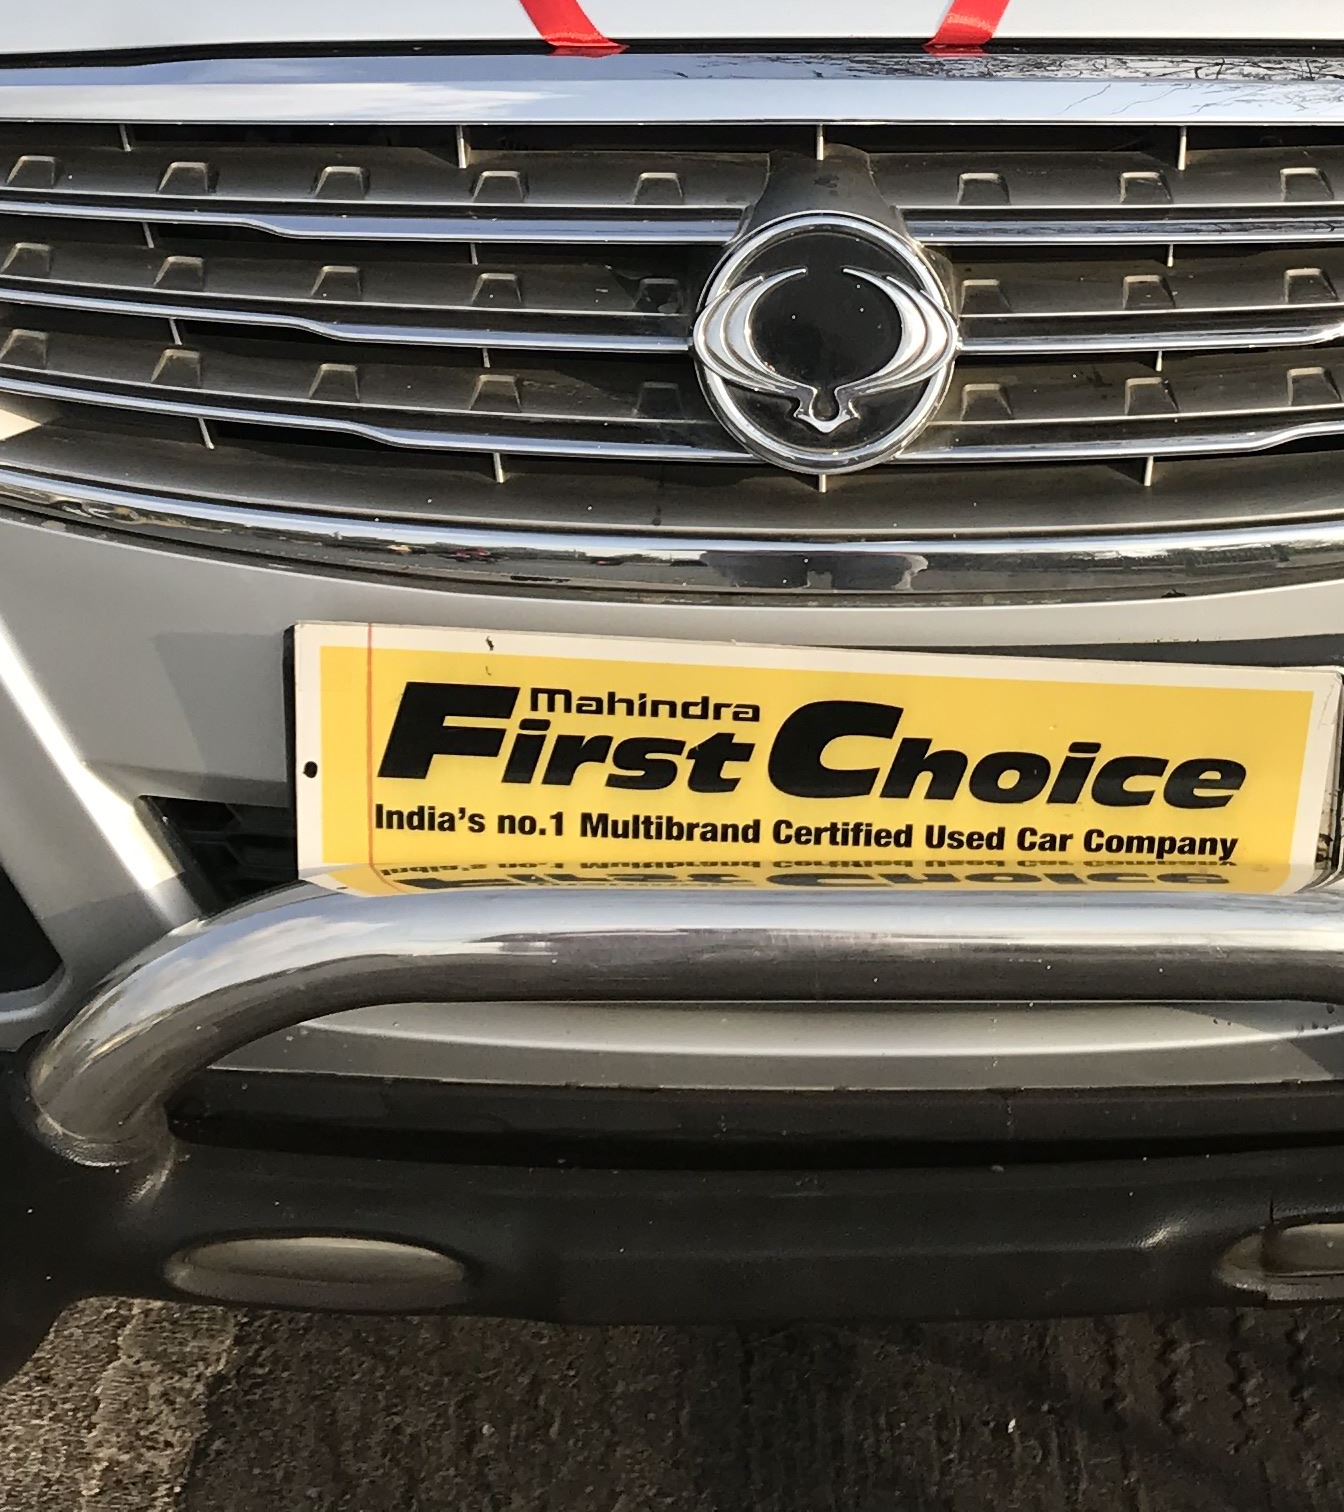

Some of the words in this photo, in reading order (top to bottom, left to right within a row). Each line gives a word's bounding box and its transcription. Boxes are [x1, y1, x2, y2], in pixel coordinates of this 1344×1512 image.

[530, 688, 760, 722] Mahindra
[377, 681, 756, 793] First
[767, 700, 1247, 809] Choice
[497, 811, 564, 837] no.1
[580, 812, 760, 844] Multibrand
[772, 819, 913, 848] Certified
[925, 824, 1005, 851] Used
[1016, 827, 1073, 853] Car
[1083, 829, 1238, 860] Company
